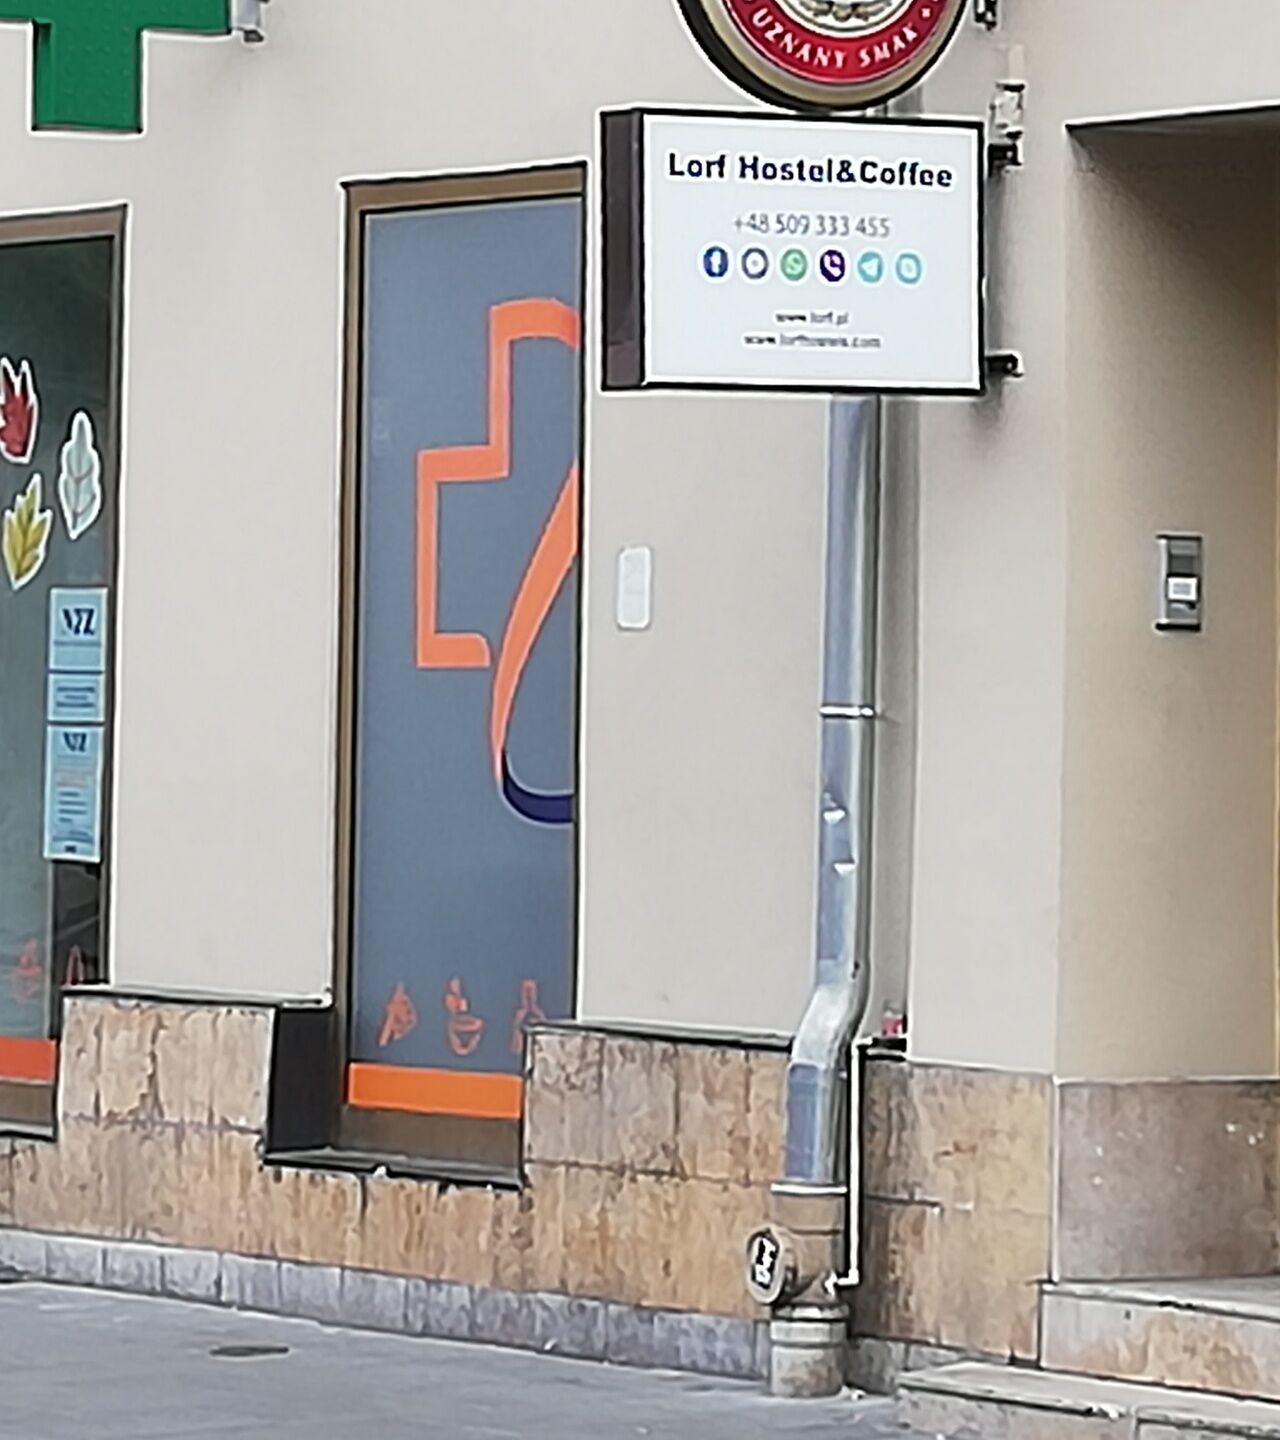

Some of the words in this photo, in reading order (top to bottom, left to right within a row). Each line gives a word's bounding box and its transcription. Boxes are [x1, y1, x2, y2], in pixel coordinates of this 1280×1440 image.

[752, 8, 848, 69] UZNANY
[858, 22, 918, 68] SMAK
[668, 152, 727, 180] Lorf
[738, 155, 954, 188] Hostel&Coffee
[733, 213, 770, 235] +48
[775, 214, 810, 236] 509
[816, 215, 850, 237] 333
[856, 217, 891, 238] 455
